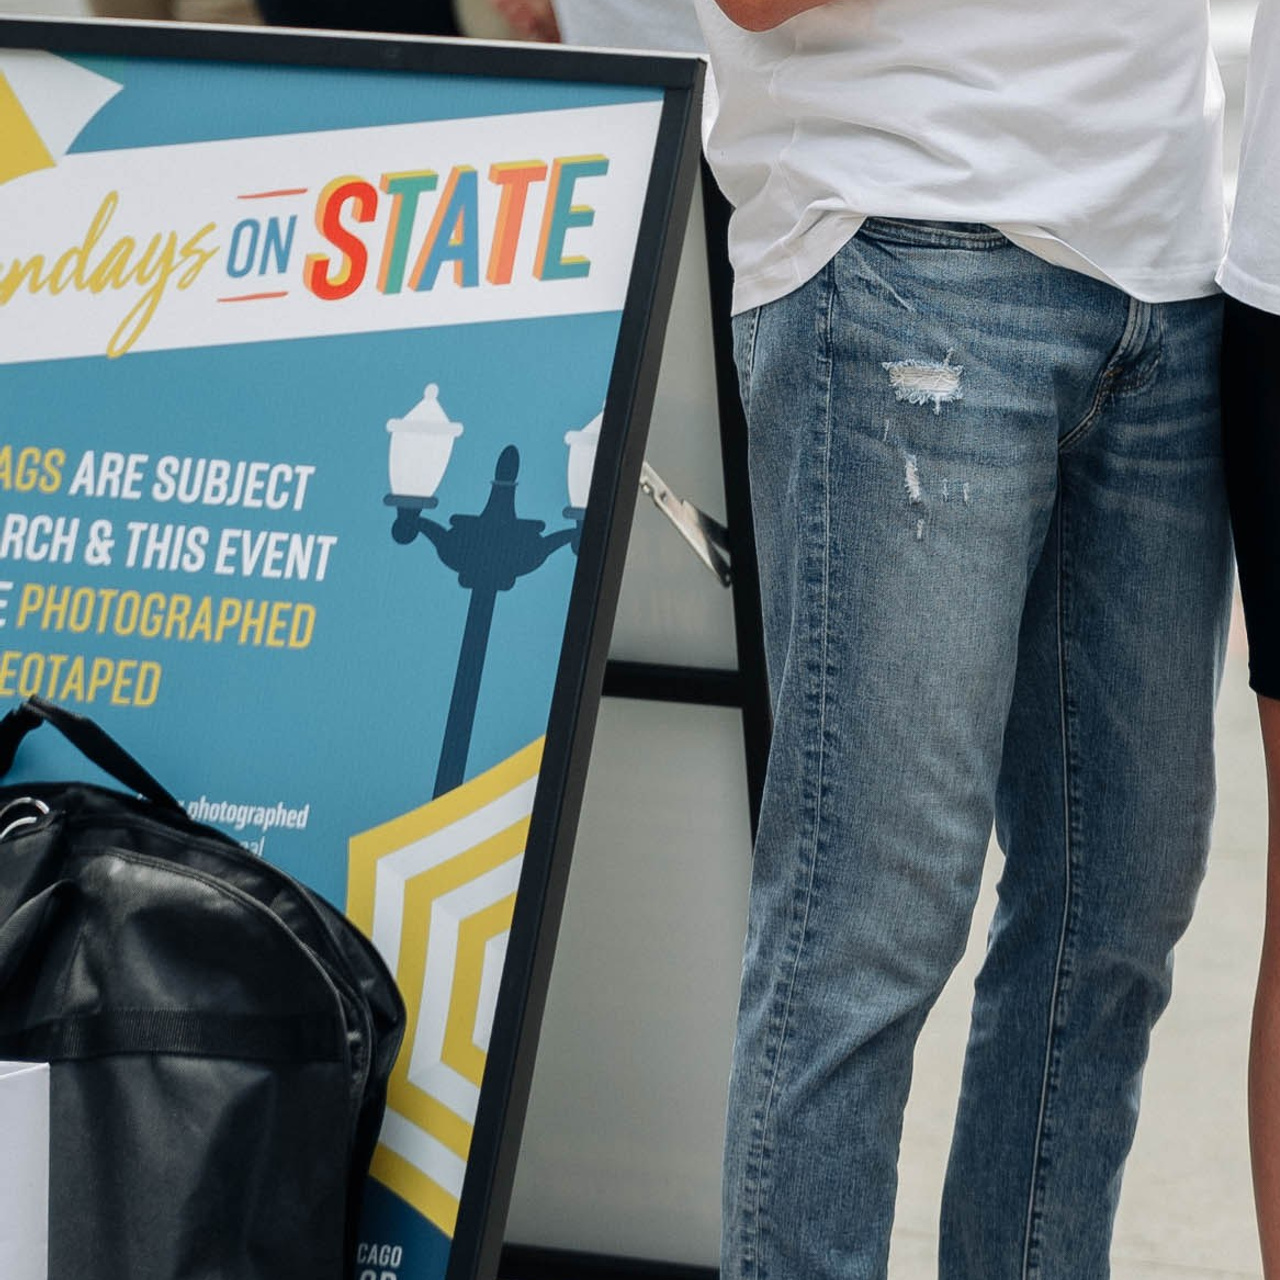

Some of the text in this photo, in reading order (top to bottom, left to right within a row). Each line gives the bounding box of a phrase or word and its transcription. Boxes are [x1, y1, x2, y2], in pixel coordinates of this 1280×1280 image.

[0, 153, 610, 358] ndays ON STATE
[68, 450, 149, 500] ARE
[152, 455, 316, 511] SUBJECT
[0, 513, 338, 581] RCH & THIS EVENT
[16, 583, 316, 648] PHOTOGRAPHED
[0, 651, 162, 707] EOTAPED
[186, 795, 310, 832] photographed
[357, 1243, 403, 1268] CAGO
